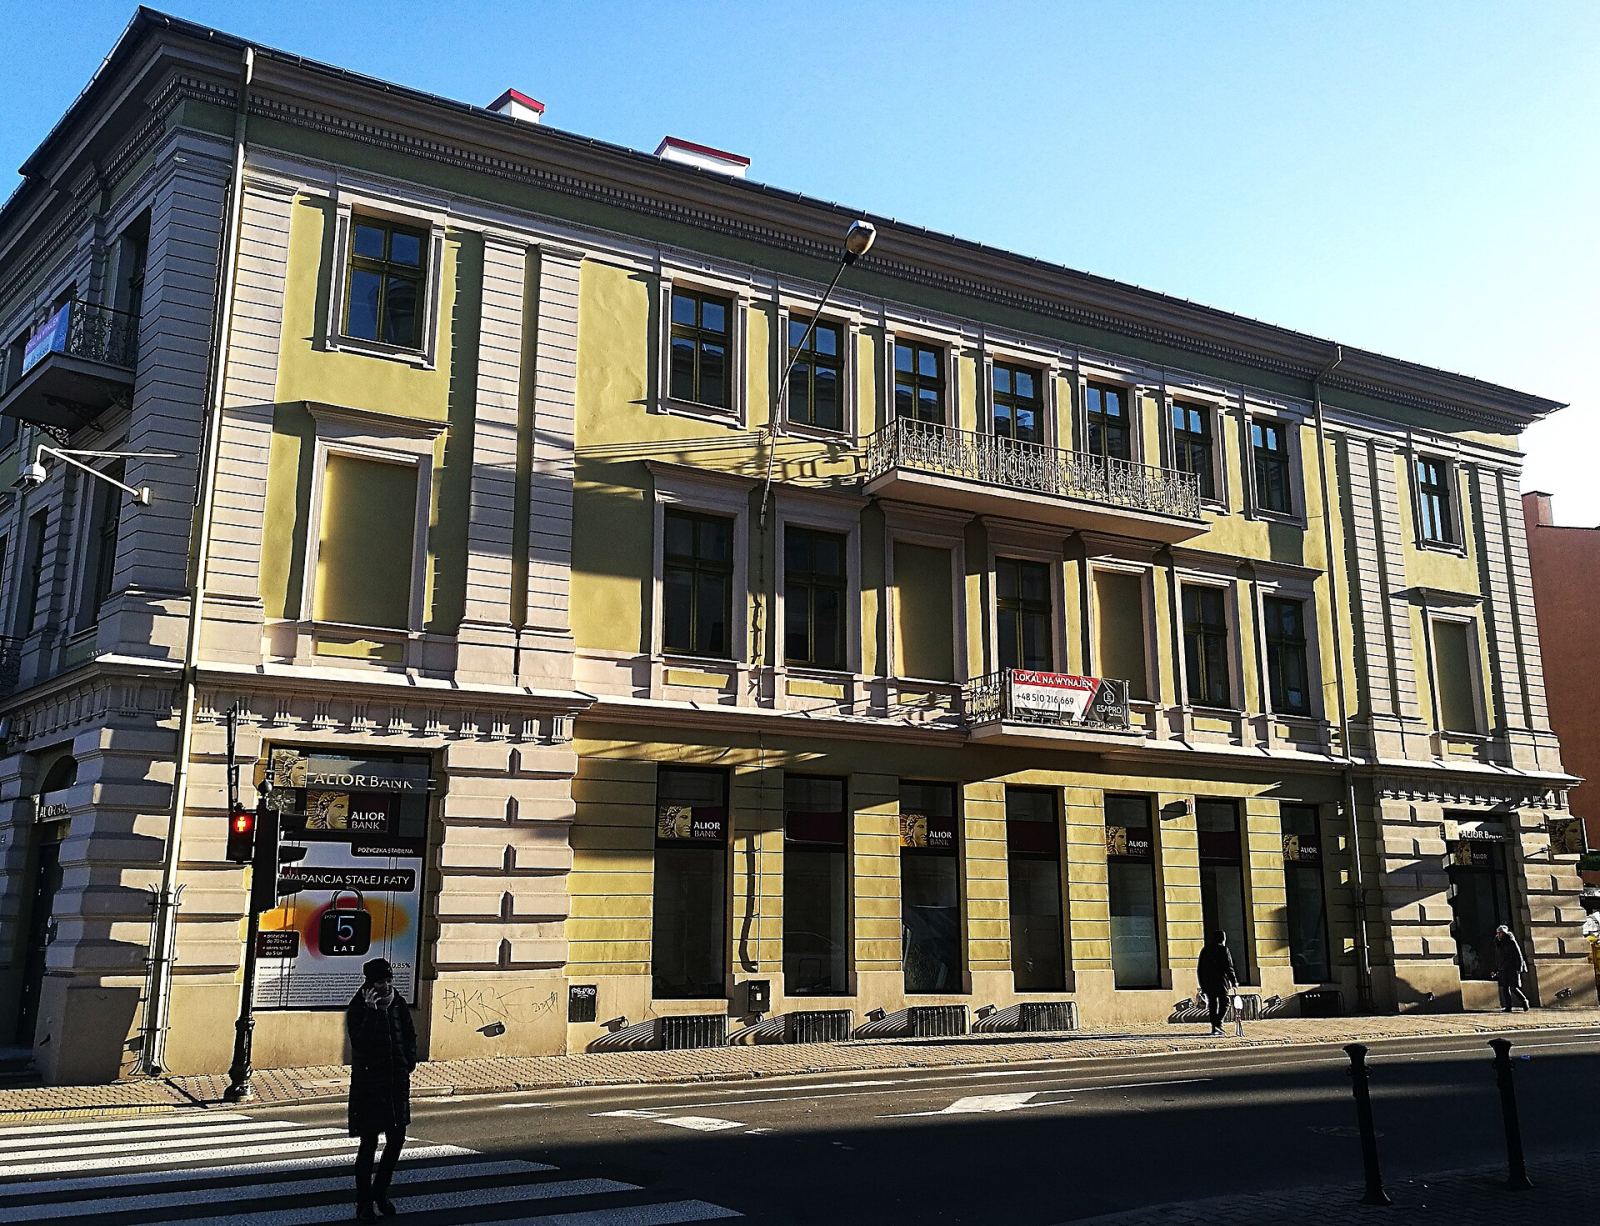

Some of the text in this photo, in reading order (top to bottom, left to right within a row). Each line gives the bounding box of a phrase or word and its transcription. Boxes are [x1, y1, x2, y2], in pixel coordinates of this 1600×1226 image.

[1015, 673, 1041, 684] LOKAL
[1042, 676, 1054, 685] NA
[1016, 693, 1075, 706] +48 510 216 669
[314, 773, 366, 787] ALIOR
[351, 811, 386, 821] ALIOR
[352, 821, 380, 830] BANK
[693, 821, 721, 830] ALIOR
[694, 830, 717, 838] BANK
[929, 830, 952, 839] ALIOR
[1128, 840, 1149, 848] ALIOR
[345, 874, 381, 885] STAŁEJ
[337, 915, 356, 940] 5
